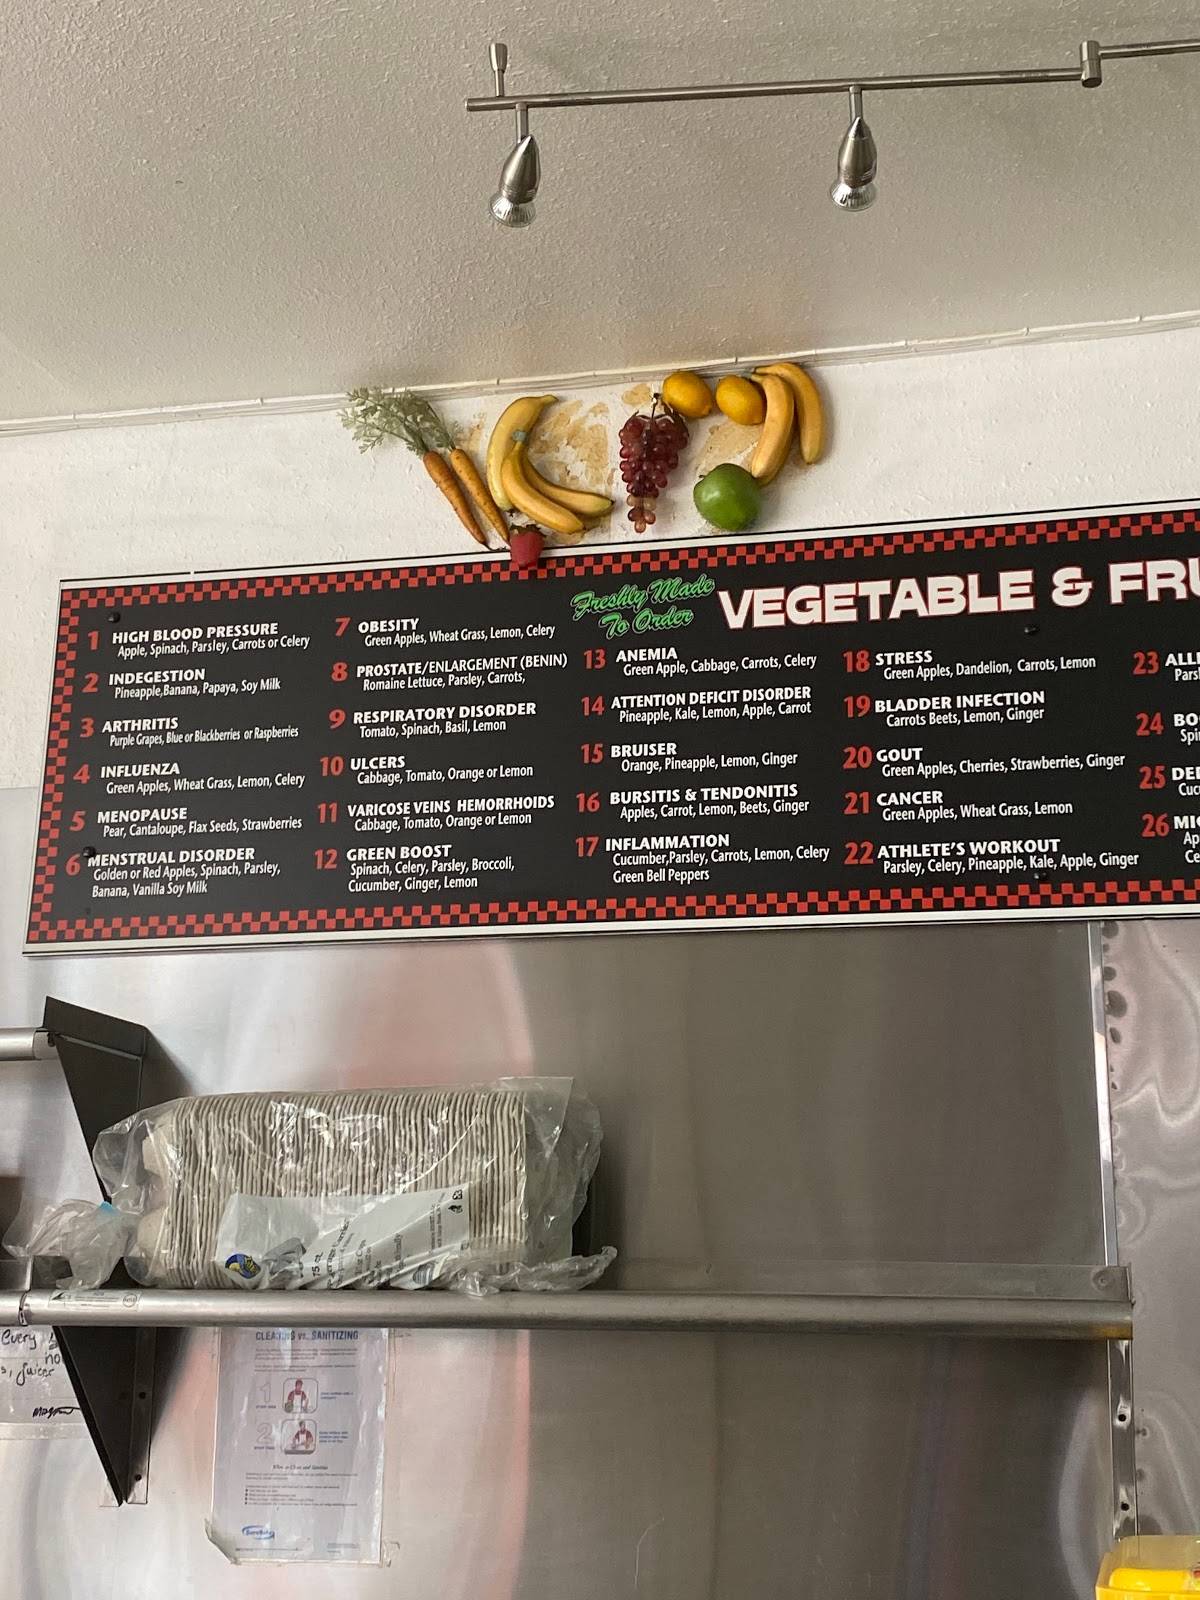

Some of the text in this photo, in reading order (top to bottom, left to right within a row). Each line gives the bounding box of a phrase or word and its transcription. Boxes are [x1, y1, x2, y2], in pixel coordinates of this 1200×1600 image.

[570, 574, 715, 621] Freshly Made
[718, 568, 1036, 629] VEGETABLE
[1051, 566, 1093, 607] &
[335, 617, 419, 637] 7 OBESITY
[600, 606, 694, 640] To Order
[87, 623, 278, 649] 1 HIGH BLOOD PRESSURE
[118, 636, 310, 659] Apple, Spinach, Parsley, Carrots or Celery
[331, 653, 567, 682] 8 PROSTATE/ENLARGEMENT (BENIN)
[583, 648, 678, 669] 13 ANEMIA
[843, 650, 933, 672] 18 STRESS
[1132, 651, 1159, 675] 23
[82, 669, 205, 692] 2 INDEGESTION
[203, 681, 239, 695] Papaya,
[241, 680, 258, 694] Soy
[260, 678, 281, 690] Milk
[363, 672, 525, 691] Romaine Lettuce, Parsley, Carrots,
[581, 687, 811, 716] 14 ATTENTION DEFICIT DISORDER
[620, 702, 811, 724] Pineapple, Kale, Lemon, Apple, Carrot
[844, 691, 1045, 718] 19 BLADDER INFECTION
[329, 703, 536, 729] 9 RESPIRATORY DISORDER
[1136, 712, 1164, 736] 24
[80, 718, 179, 738] 3 ARTHRITIS
[581, 743, 677, 764] 15 BRUISER
[843, 746, 923, 769] 20 GOUT
[73, 763, 180, 784] 4 INFLUENZA
[320, 756, 406, 776] 10 ULCERS
[357, 765, 533, 786] Cabbage, Tomato, Orange or Lemon
[882, 754, 1125, 778] Green Apples, Cherries, Strawberries, Ginger
[1139, 765, 1166, 790] 25
[318, 796, 555, 823] 11 VARICOSE VEINS HEMORRHOIDS
[576, 784, 798, 812] 16 BURSITIS & TENDONITIS
[844, 791, 943, 814] 21 CANCER
[70, 808, 187, 831] 5 MENOPAUSE
[103, 817, 302, 838] Pear, Cantaloupe, Flax Seeds, Strawberries
[1141, 813, 1169, 837] 26
[315, 845, 451, 869] 12 GREEN BOOST
[576, 834, 730, 857] 17 INFLAMMATION
[711, 849, 751, 863] Carrots,
[755, 847, 793, 861] Lemon,
[796, 845, 830, 861] Celery
[844, 842, 873, 864] 22
[969, 839, 1060, 855] WORKOUT
[66, 848, 255, 875] 6 MENSTRUAL DISORDER
[94, 862, 281, 881] Golden or Red Apples, Spinach, Parsley,
[351, 857, 515, 877] Spinach, Celery, Parsley, Broccoli,
[883, 852, 1139, 876] Parsley, Celery, Pineapple, Kale, Apple, Ginger
[348, 876, 477, 893] Cucumber, Ginger, Lemon
[613, 868, 709, 884] Green Bell Peppers
[92, 880, 208, 898] Banana, Vanilla Soy Milk
[311, 1330, 359, 1341] SANITIZING
